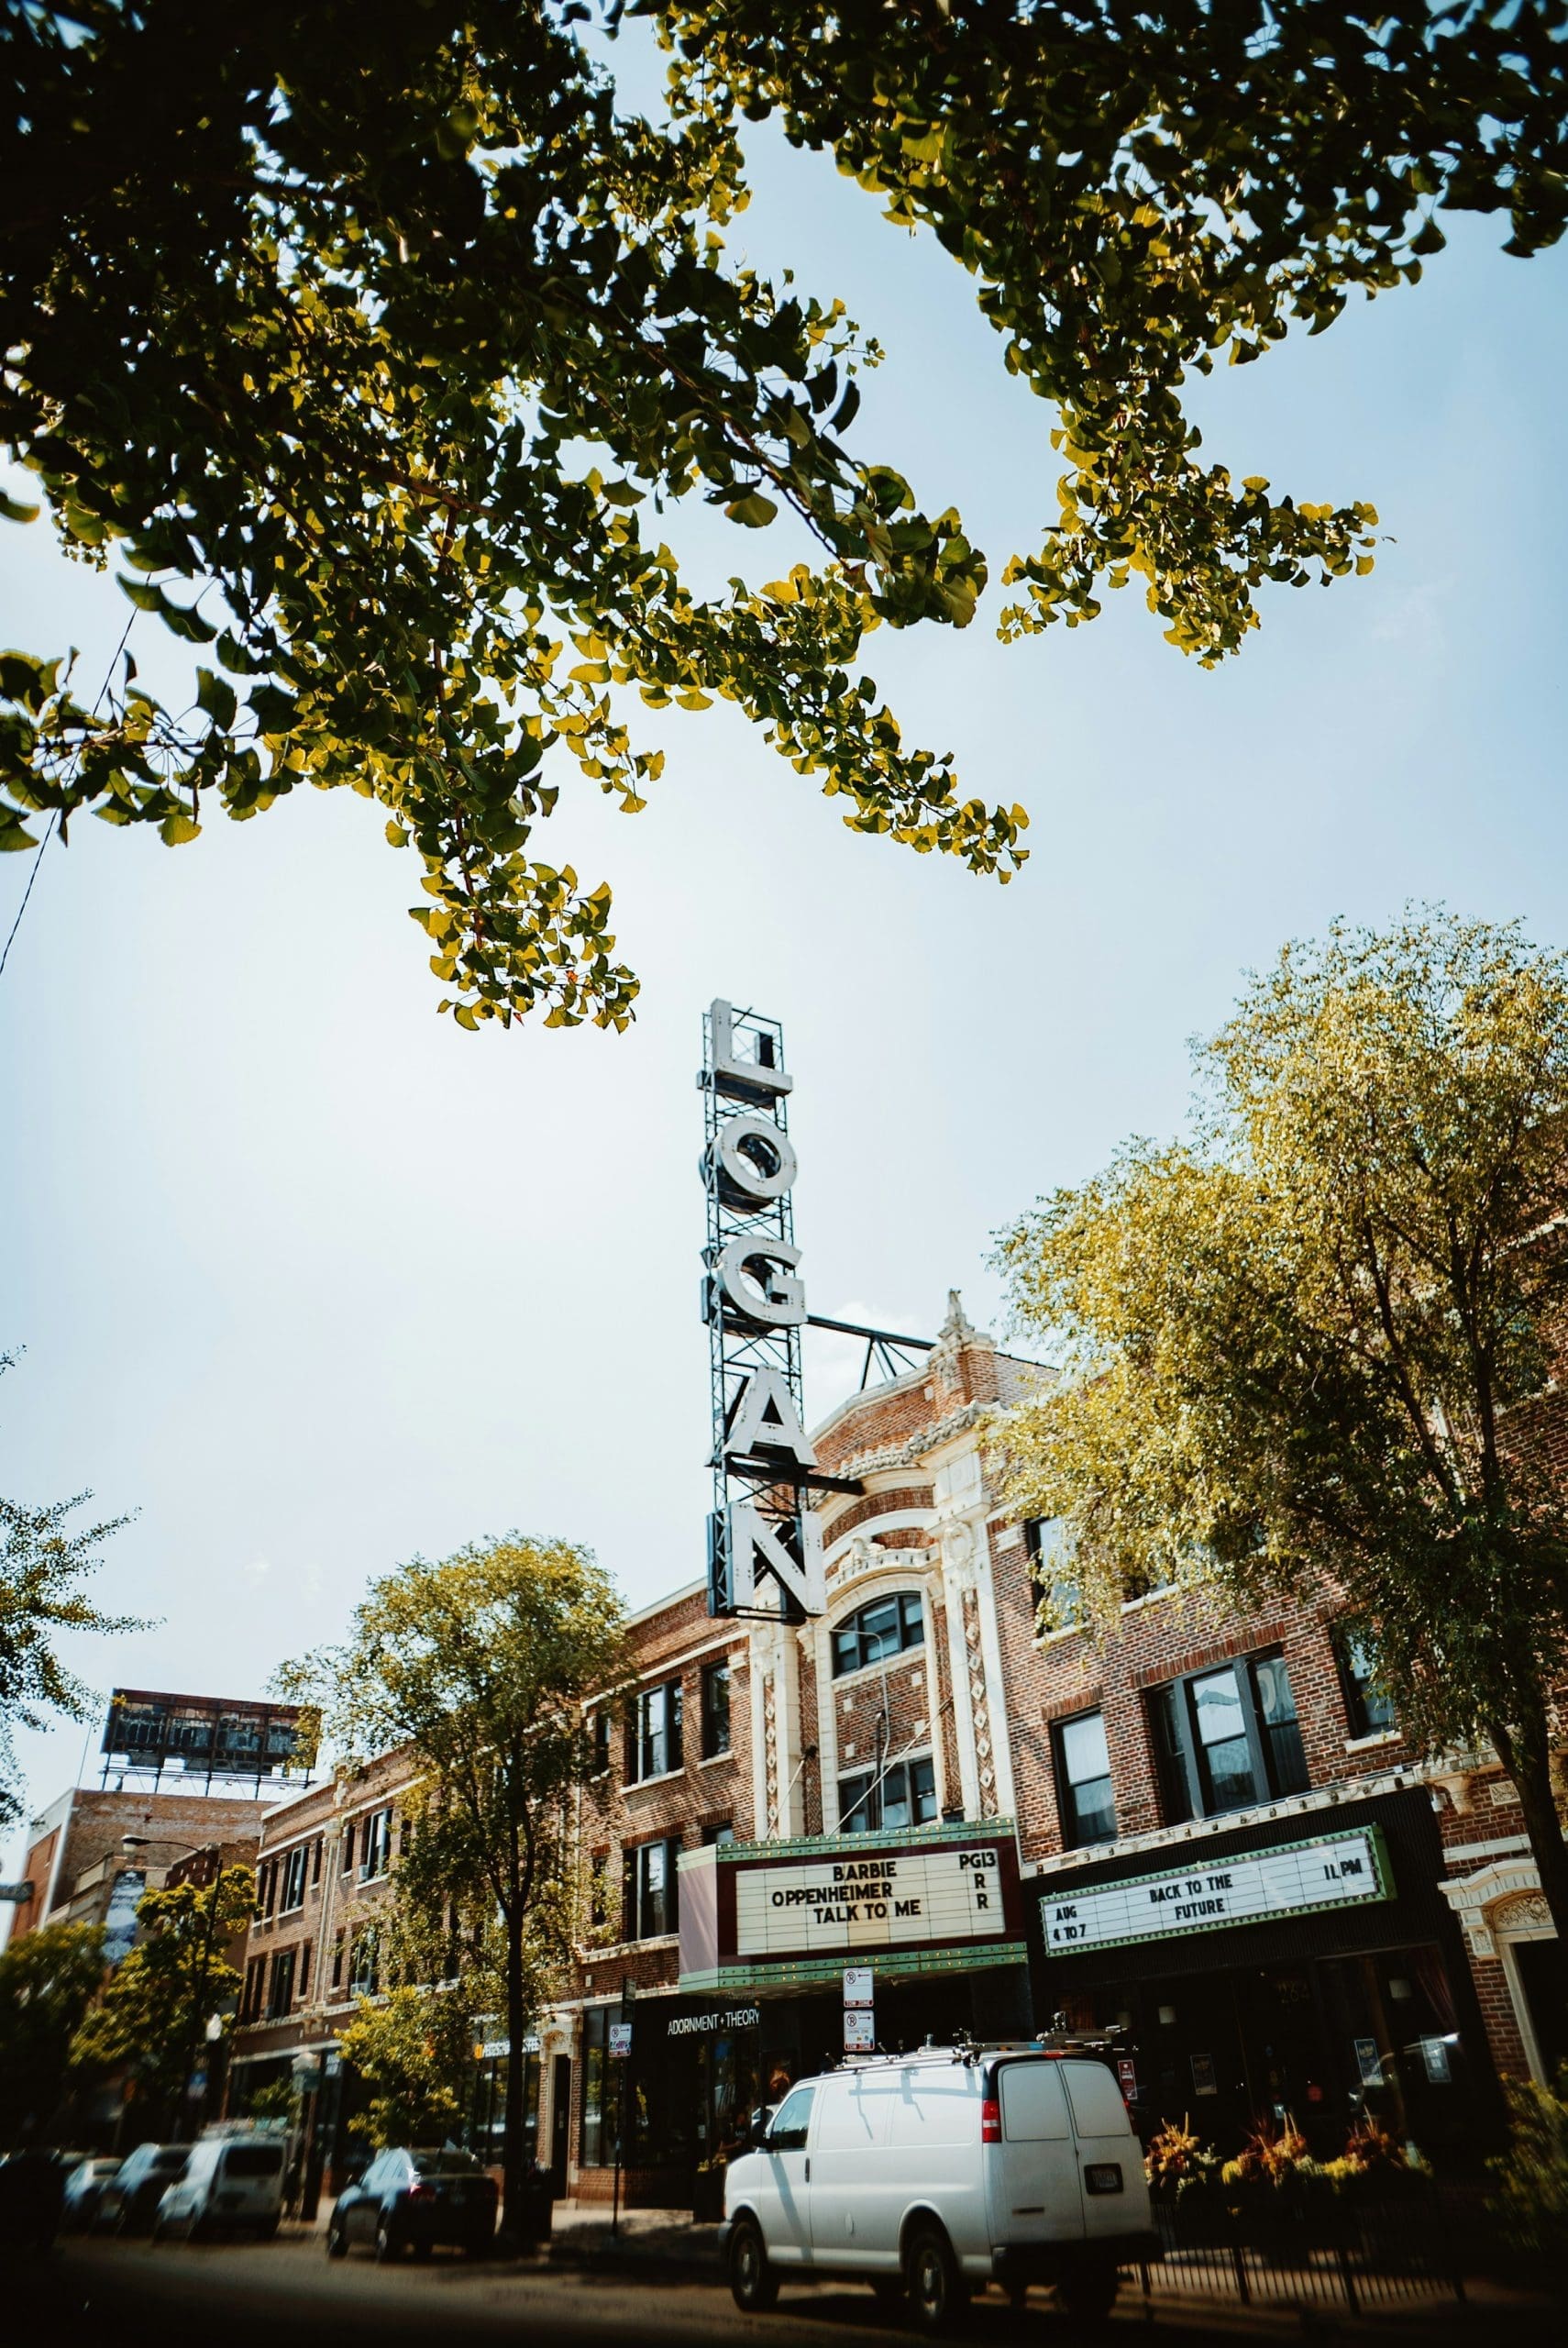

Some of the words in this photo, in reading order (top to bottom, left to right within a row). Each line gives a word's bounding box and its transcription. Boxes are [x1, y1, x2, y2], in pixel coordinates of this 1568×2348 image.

[709, 998, 827, 1618] LOGAN
[833, 1861, 897, 1882] BARBIE
[959, 1851, 997, 1870] PG13
[974, 1873, 987, 1889] R
[1149, 1883, 1182, 1903] BACK
[1185, 1880, 1202, 1896] TO
[1206, 1873, 1233, 1891] THE
[771, 1881, 893, 1907] OPPENHEIMER
[977, 1893, 989, 1910] R
[813, 1905, 859, 1924] TALK
[864, 1902, 888, 1920] TO
[895, 1899, 922, 1917] ME
[1055, 1905, 1077, 1922] AUG
[1174, 1898, 1226, 1921] FUTURE
[1064, 1925, 1078, 1940] TO
[1078, 1923, 1087, 1938] 7
[667, 2013, 720, 2035] ADORNMENT
[724, 2009, 760, 2028] THEORY
